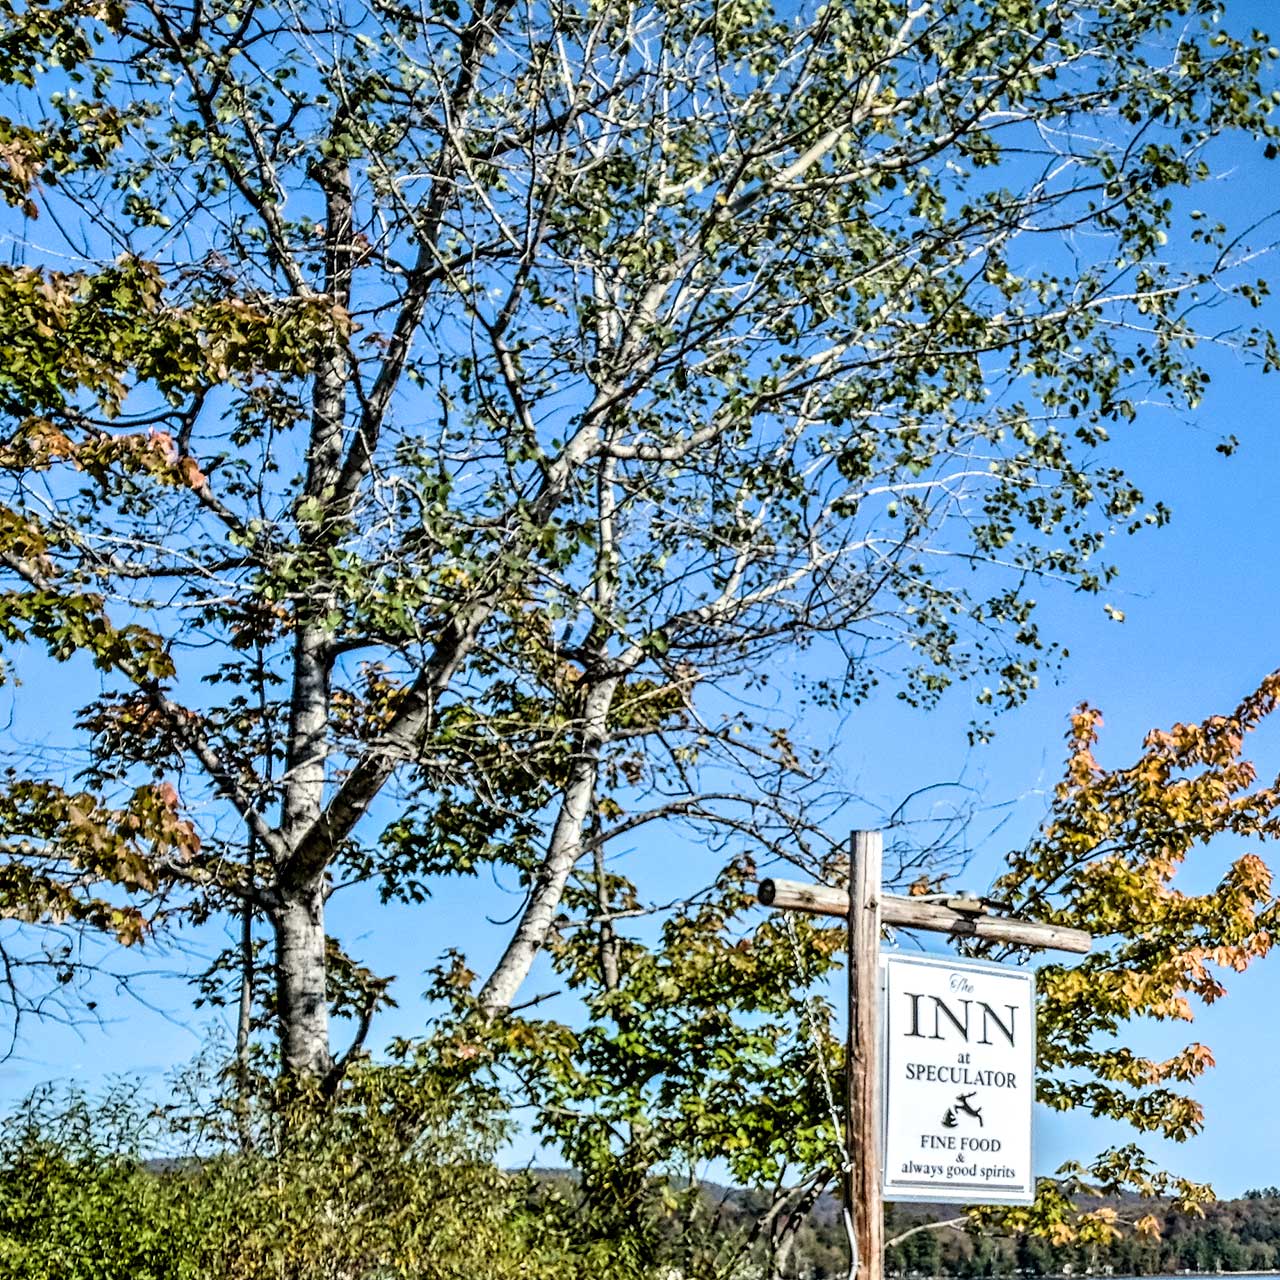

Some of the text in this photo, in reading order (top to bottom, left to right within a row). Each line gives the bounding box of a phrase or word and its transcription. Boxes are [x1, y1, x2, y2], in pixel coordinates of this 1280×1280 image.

[949, 973, 975, 993] The
[903, 992, 1019, 1047] INN
[957, 1053, 971, 1064] at
[905, 1063, 1017, 1089] SPECULATOR
[920, 1135, 1002, 1152] FINE FOOD
[955, 1153, 965, 1163] &
[901, 1161, 1016, 1181] always good spirits
